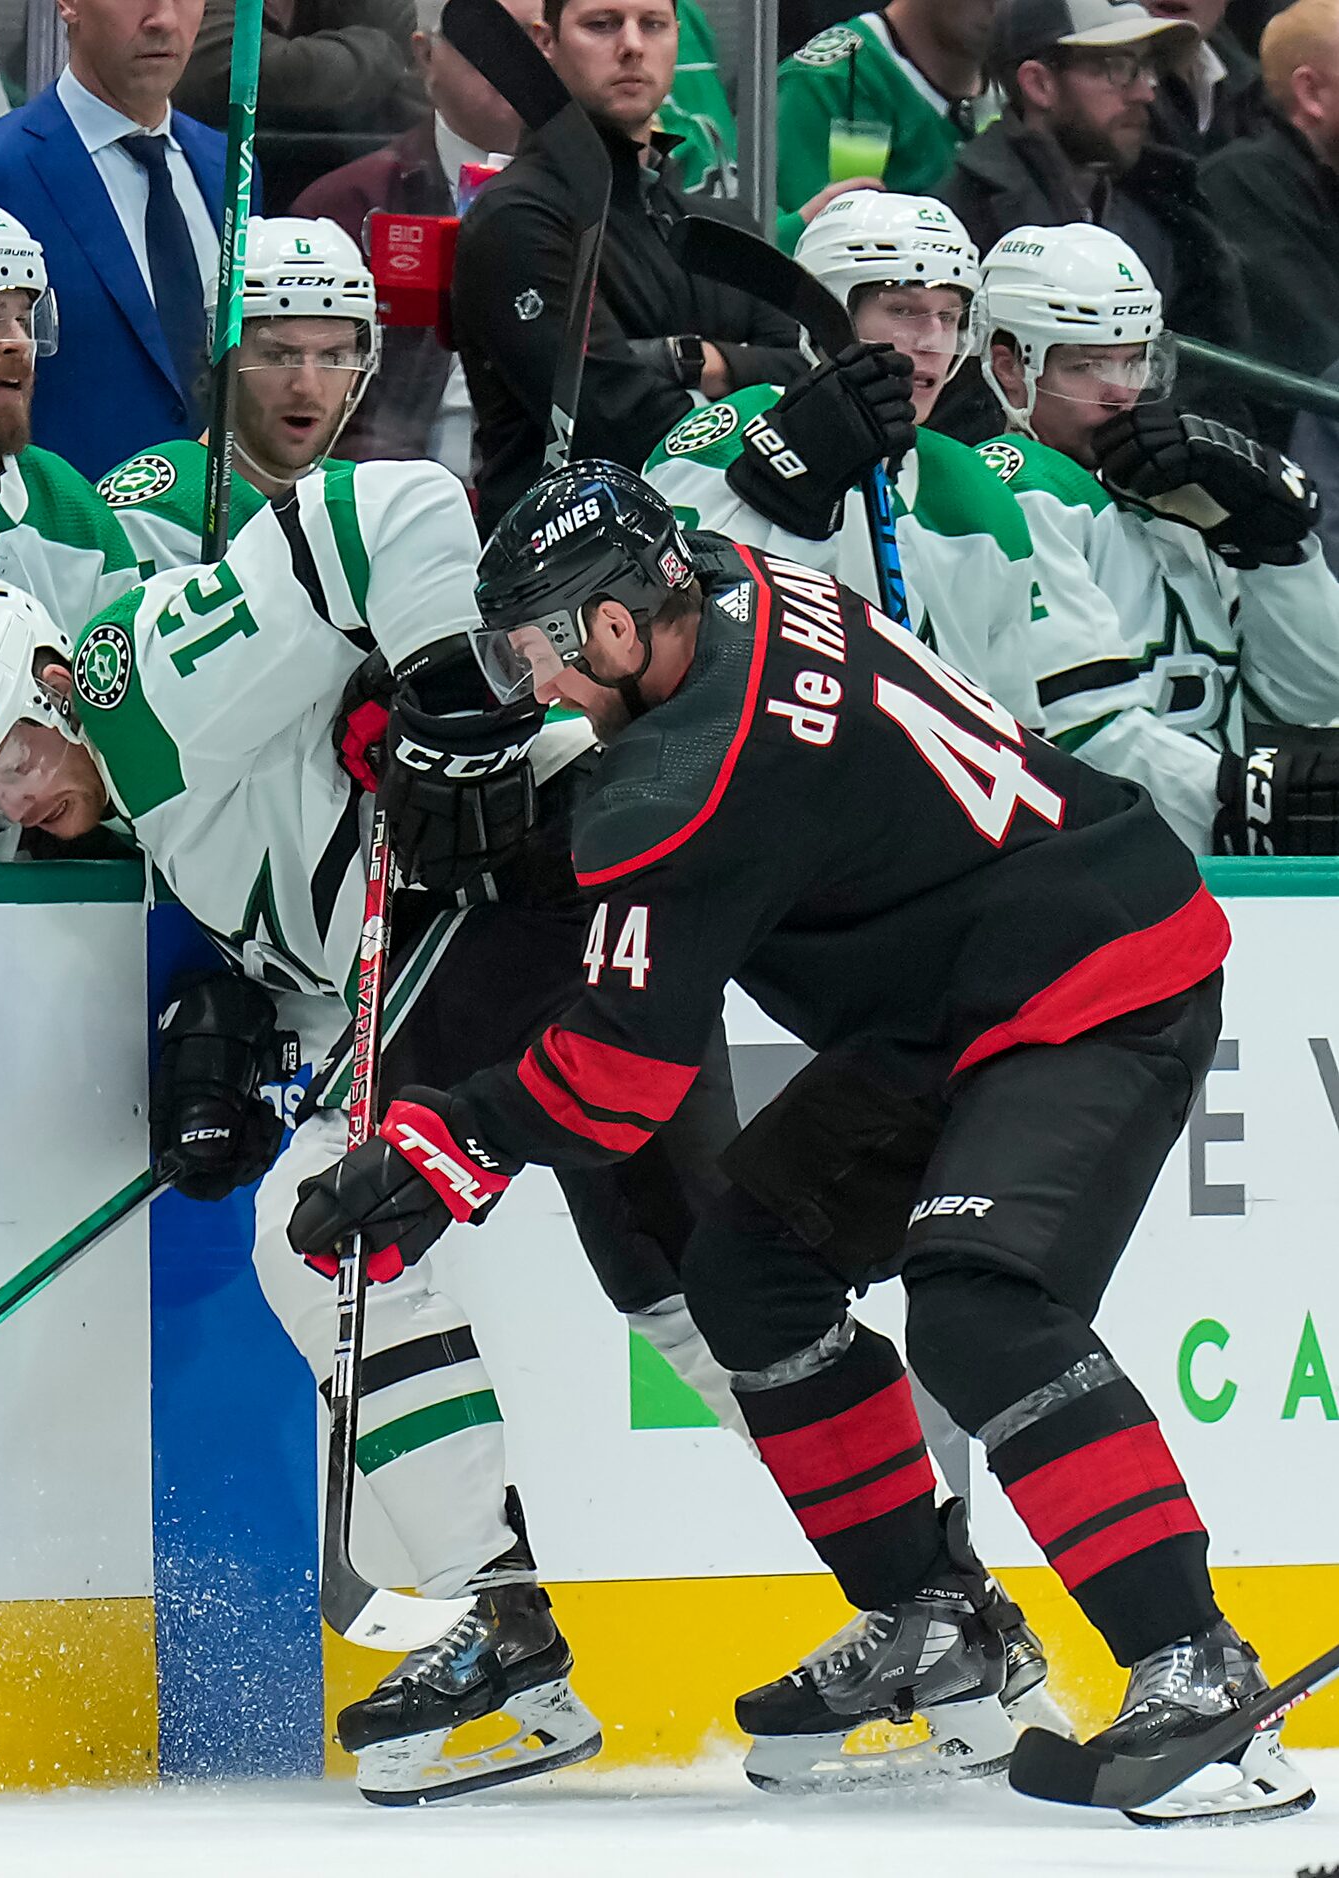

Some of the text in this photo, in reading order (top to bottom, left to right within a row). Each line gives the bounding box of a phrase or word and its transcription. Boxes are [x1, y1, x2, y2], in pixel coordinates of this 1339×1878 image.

[294, 238, 312, 255] 6
[389, 224, 423, 243] BIO
[276, 276, 337, 287] CCM
[1117, 262, 1134, 282] 4
[1112, 304, 1154, 317] CCM
[530, 497, 602, 555] CANES
[766, 670, 843, 747] de
[863, 601, 1066, 848] 44
[395, 733, 540, 778] CCM
[370, 809, 387, 881] TRUE
[582, 902, 652, 990] 44
[180, 1127, 231, 1144] CCM
[396, 1123, 492, 1209] TRU
[880, 1666, 905, 1682] PRO
